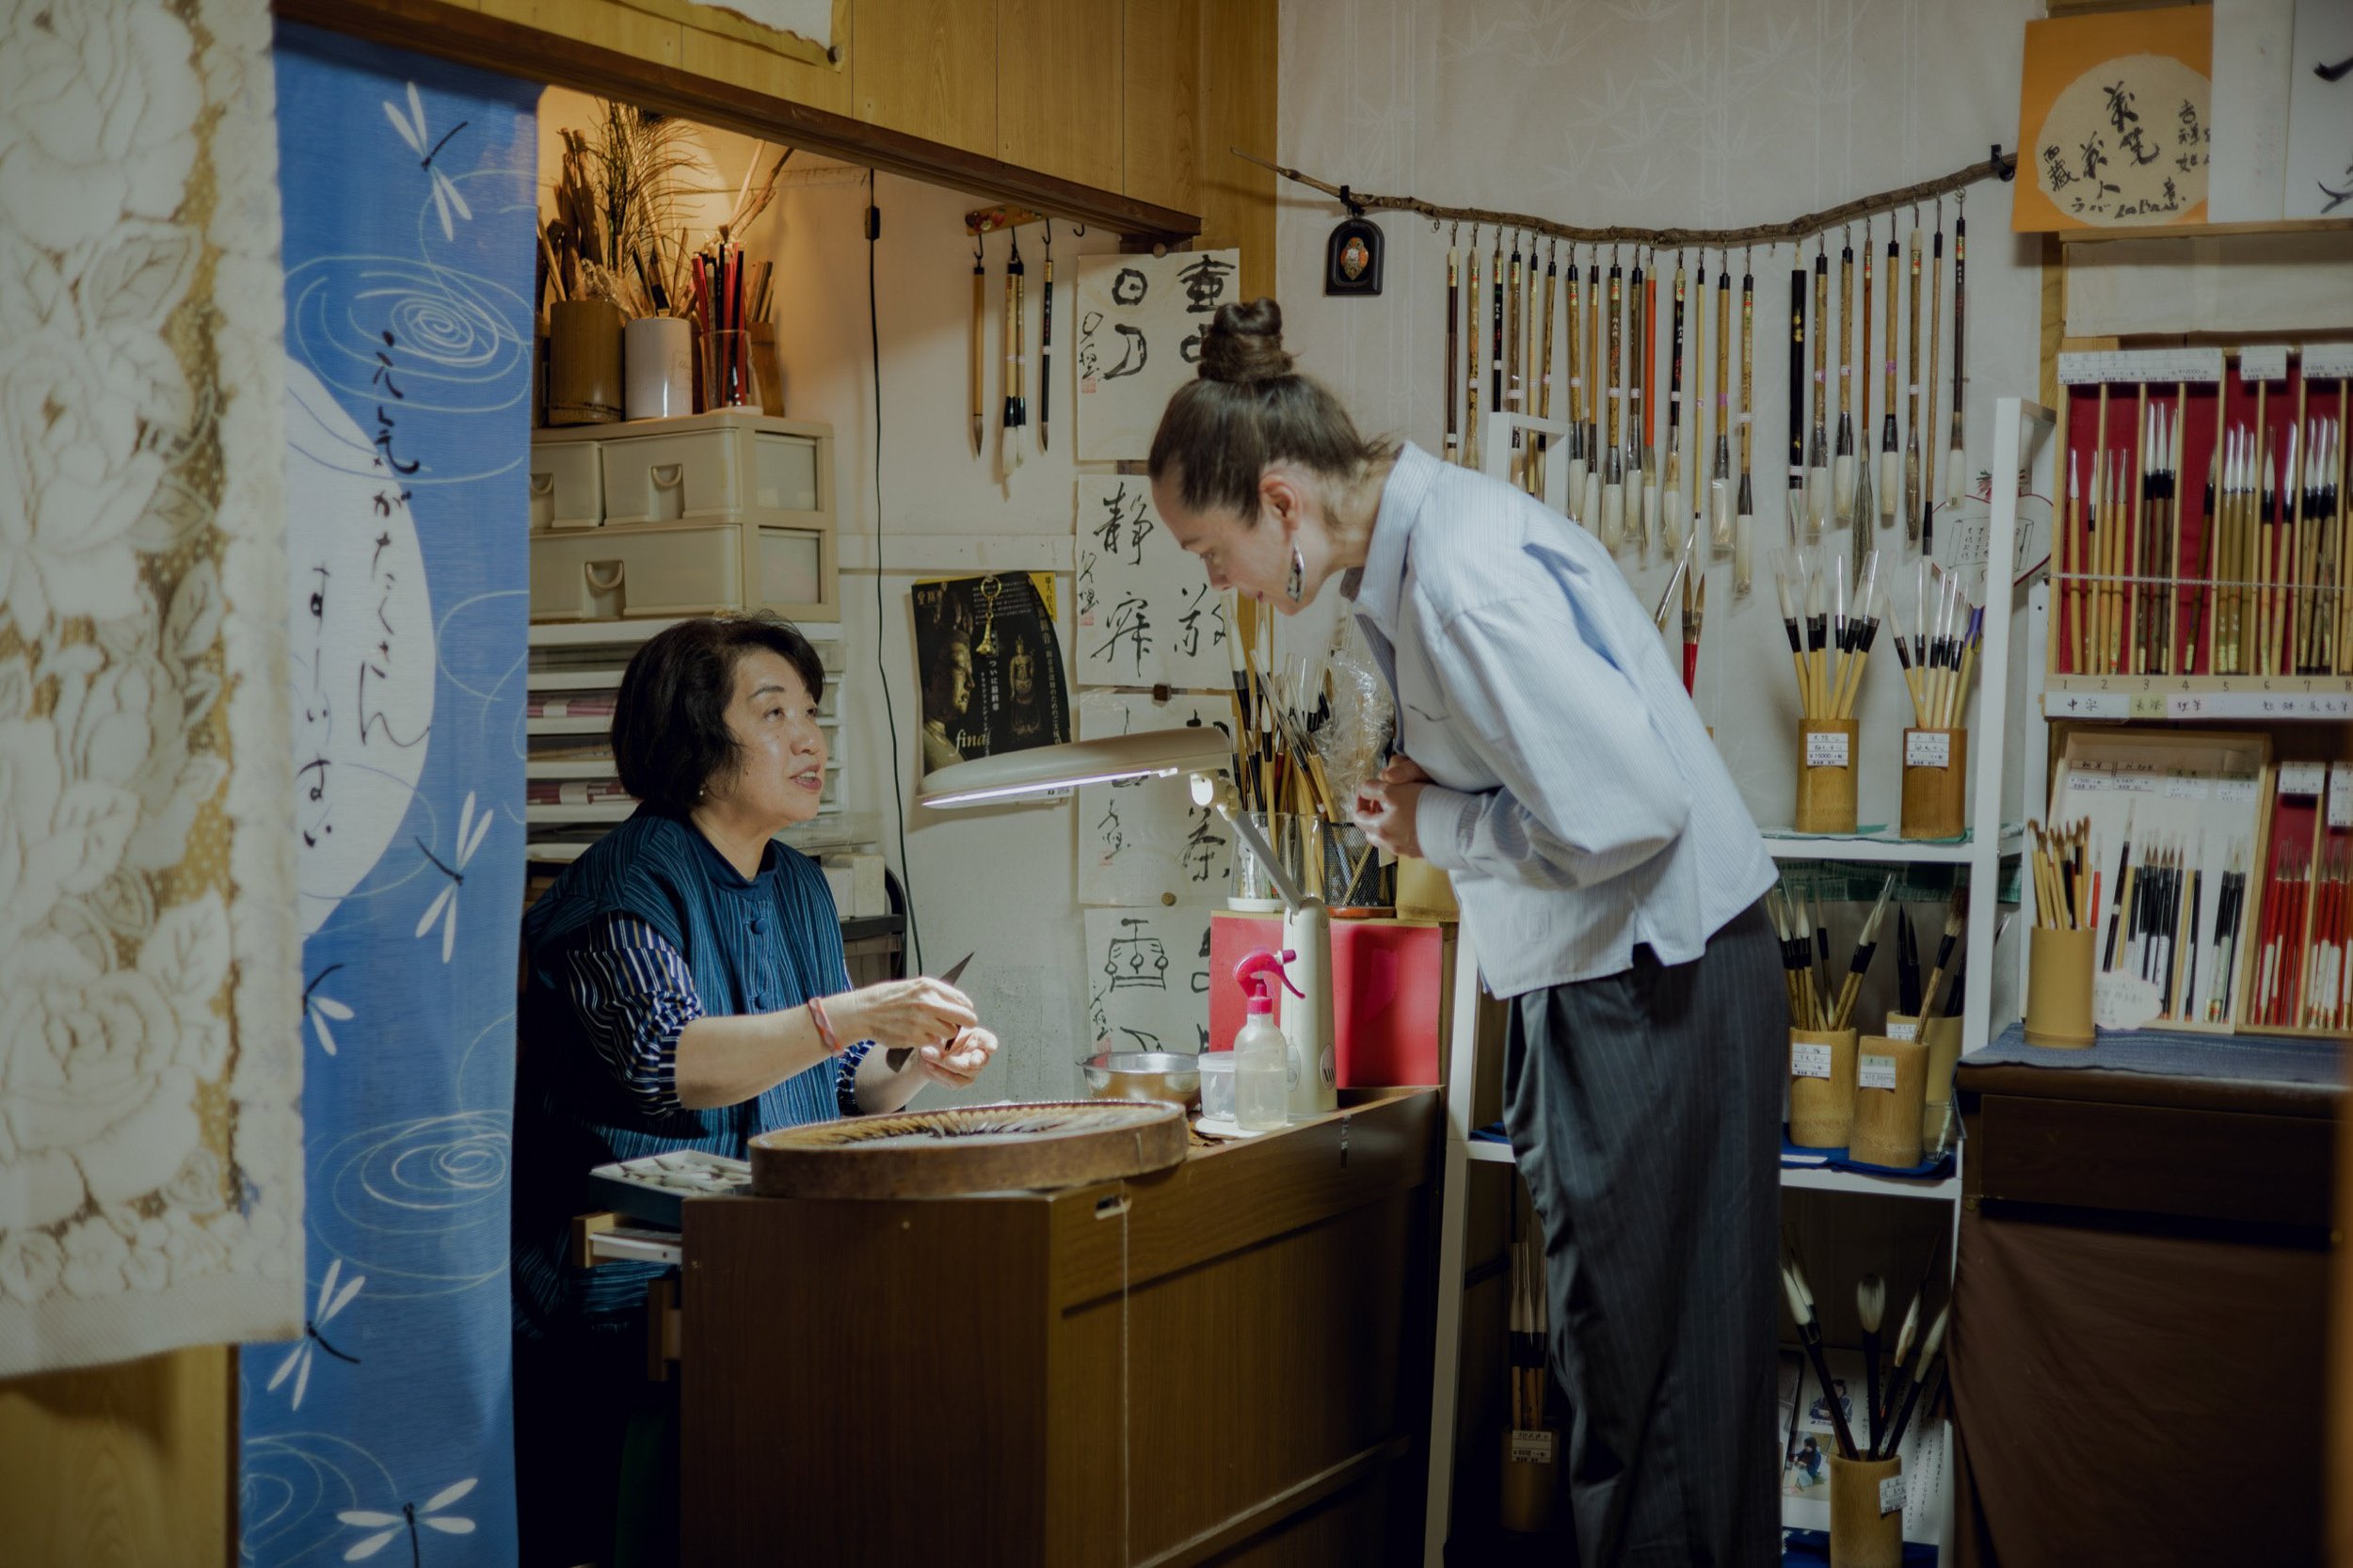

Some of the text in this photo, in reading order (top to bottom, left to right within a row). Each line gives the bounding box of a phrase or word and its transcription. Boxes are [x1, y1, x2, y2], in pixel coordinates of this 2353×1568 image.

[2062, 679, 2068, 691] 1
[2100, 679, 2109, 691] 2
[2142, 678, 2151, 692] 3
[2181, 679, 2191, 693] 4
[2222, 679, 2231, 693] 5
[2263, 679, 2271, 692] 6
[2303, 679, 2313, 694] 7
[2344, 679, 2353, 693] 8
